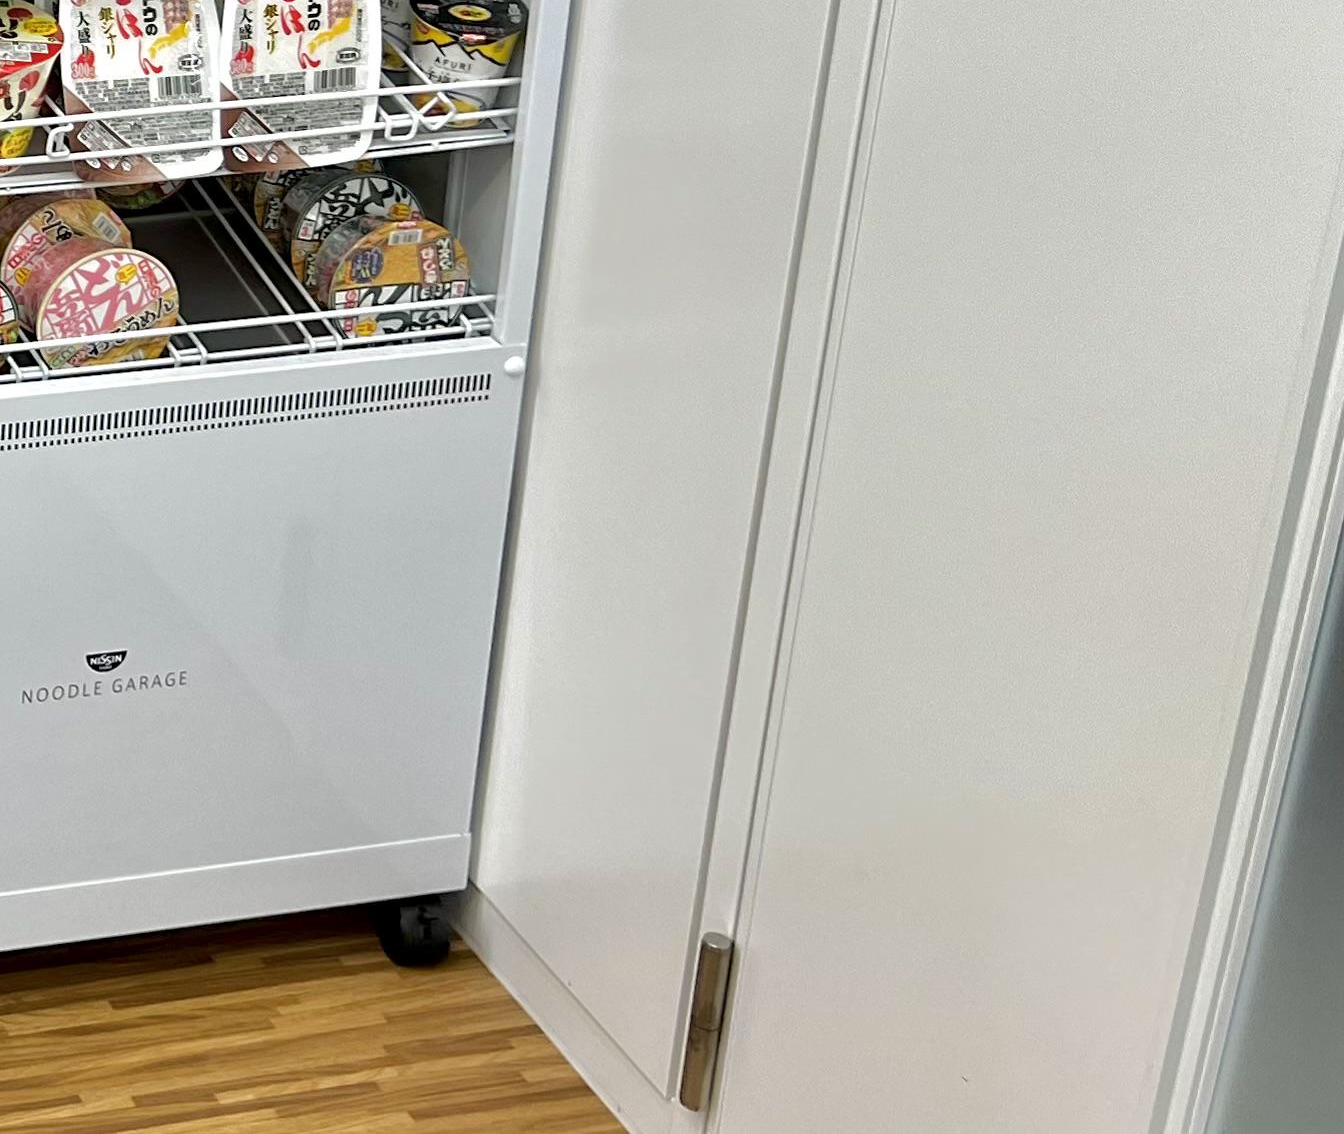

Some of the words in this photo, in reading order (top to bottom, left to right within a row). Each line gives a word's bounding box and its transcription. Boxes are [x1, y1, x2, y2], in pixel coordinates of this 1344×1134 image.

[75, 11, 93, 59] 大盛り
[97, 7, 117, 59] 銀シャリ
[238, 8, 254, 54] 大盛り
[262, 3, 280, 55] 銀シャリ
[434, 56, 473, 71] AFURI
[76, 254, 143, 334] どん
[137, 260, 162, 298] 日清の
[90, 653, 123, 666] NISSIN
[22, 681, 103, 704] NOODLE
[112, 671, 188, 694] GARAGE
